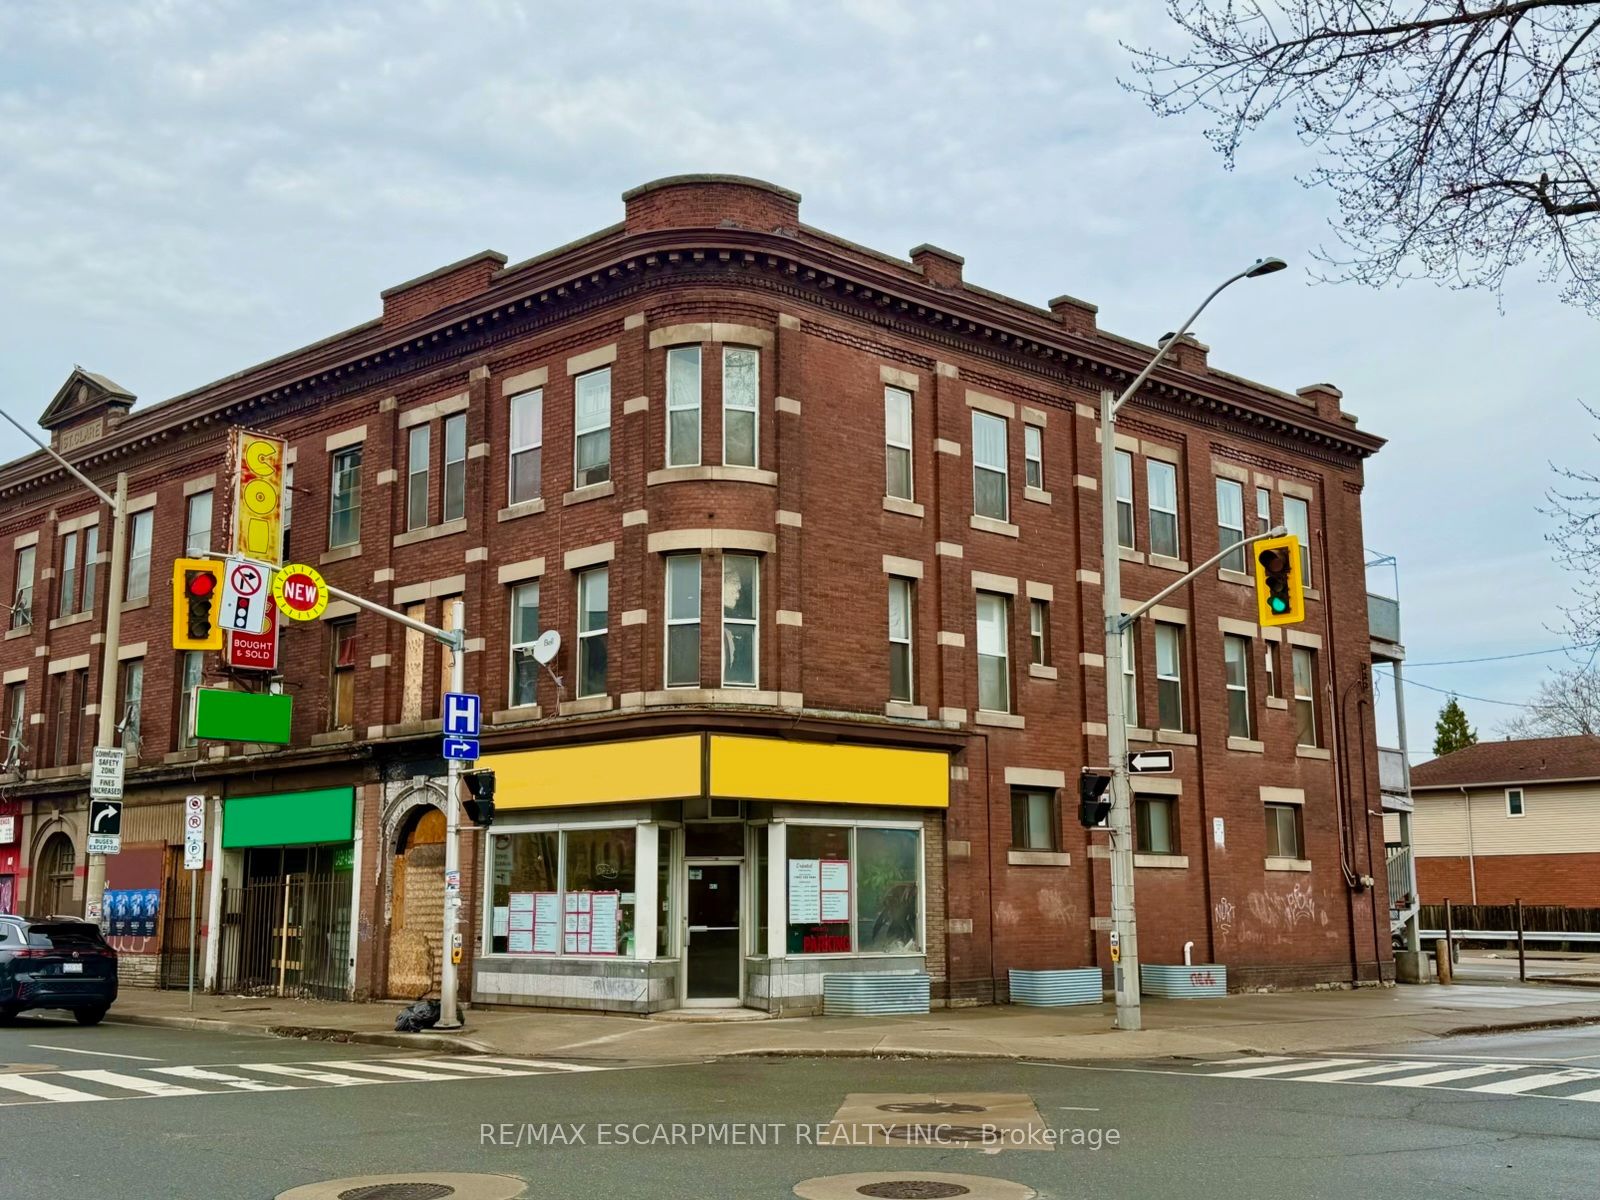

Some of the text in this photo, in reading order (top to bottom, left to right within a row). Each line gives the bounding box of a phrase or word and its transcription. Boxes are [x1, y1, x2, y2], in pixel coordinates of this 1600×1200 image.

[284, 581, 317, 603] NEW
[234, 639, 272, 650] BOUGHT
[236, 649, 270, 659] & SOLD
[449, 697, 475, 732] H
[95, 750, 123, 759] COMMUNITY
[98, 759, 119, 767] SAFETY
[100, 779, 115, 787] FINES
[93, 787, 121, 795] INCREASED
[804, 935, 852, 952] PARKING
